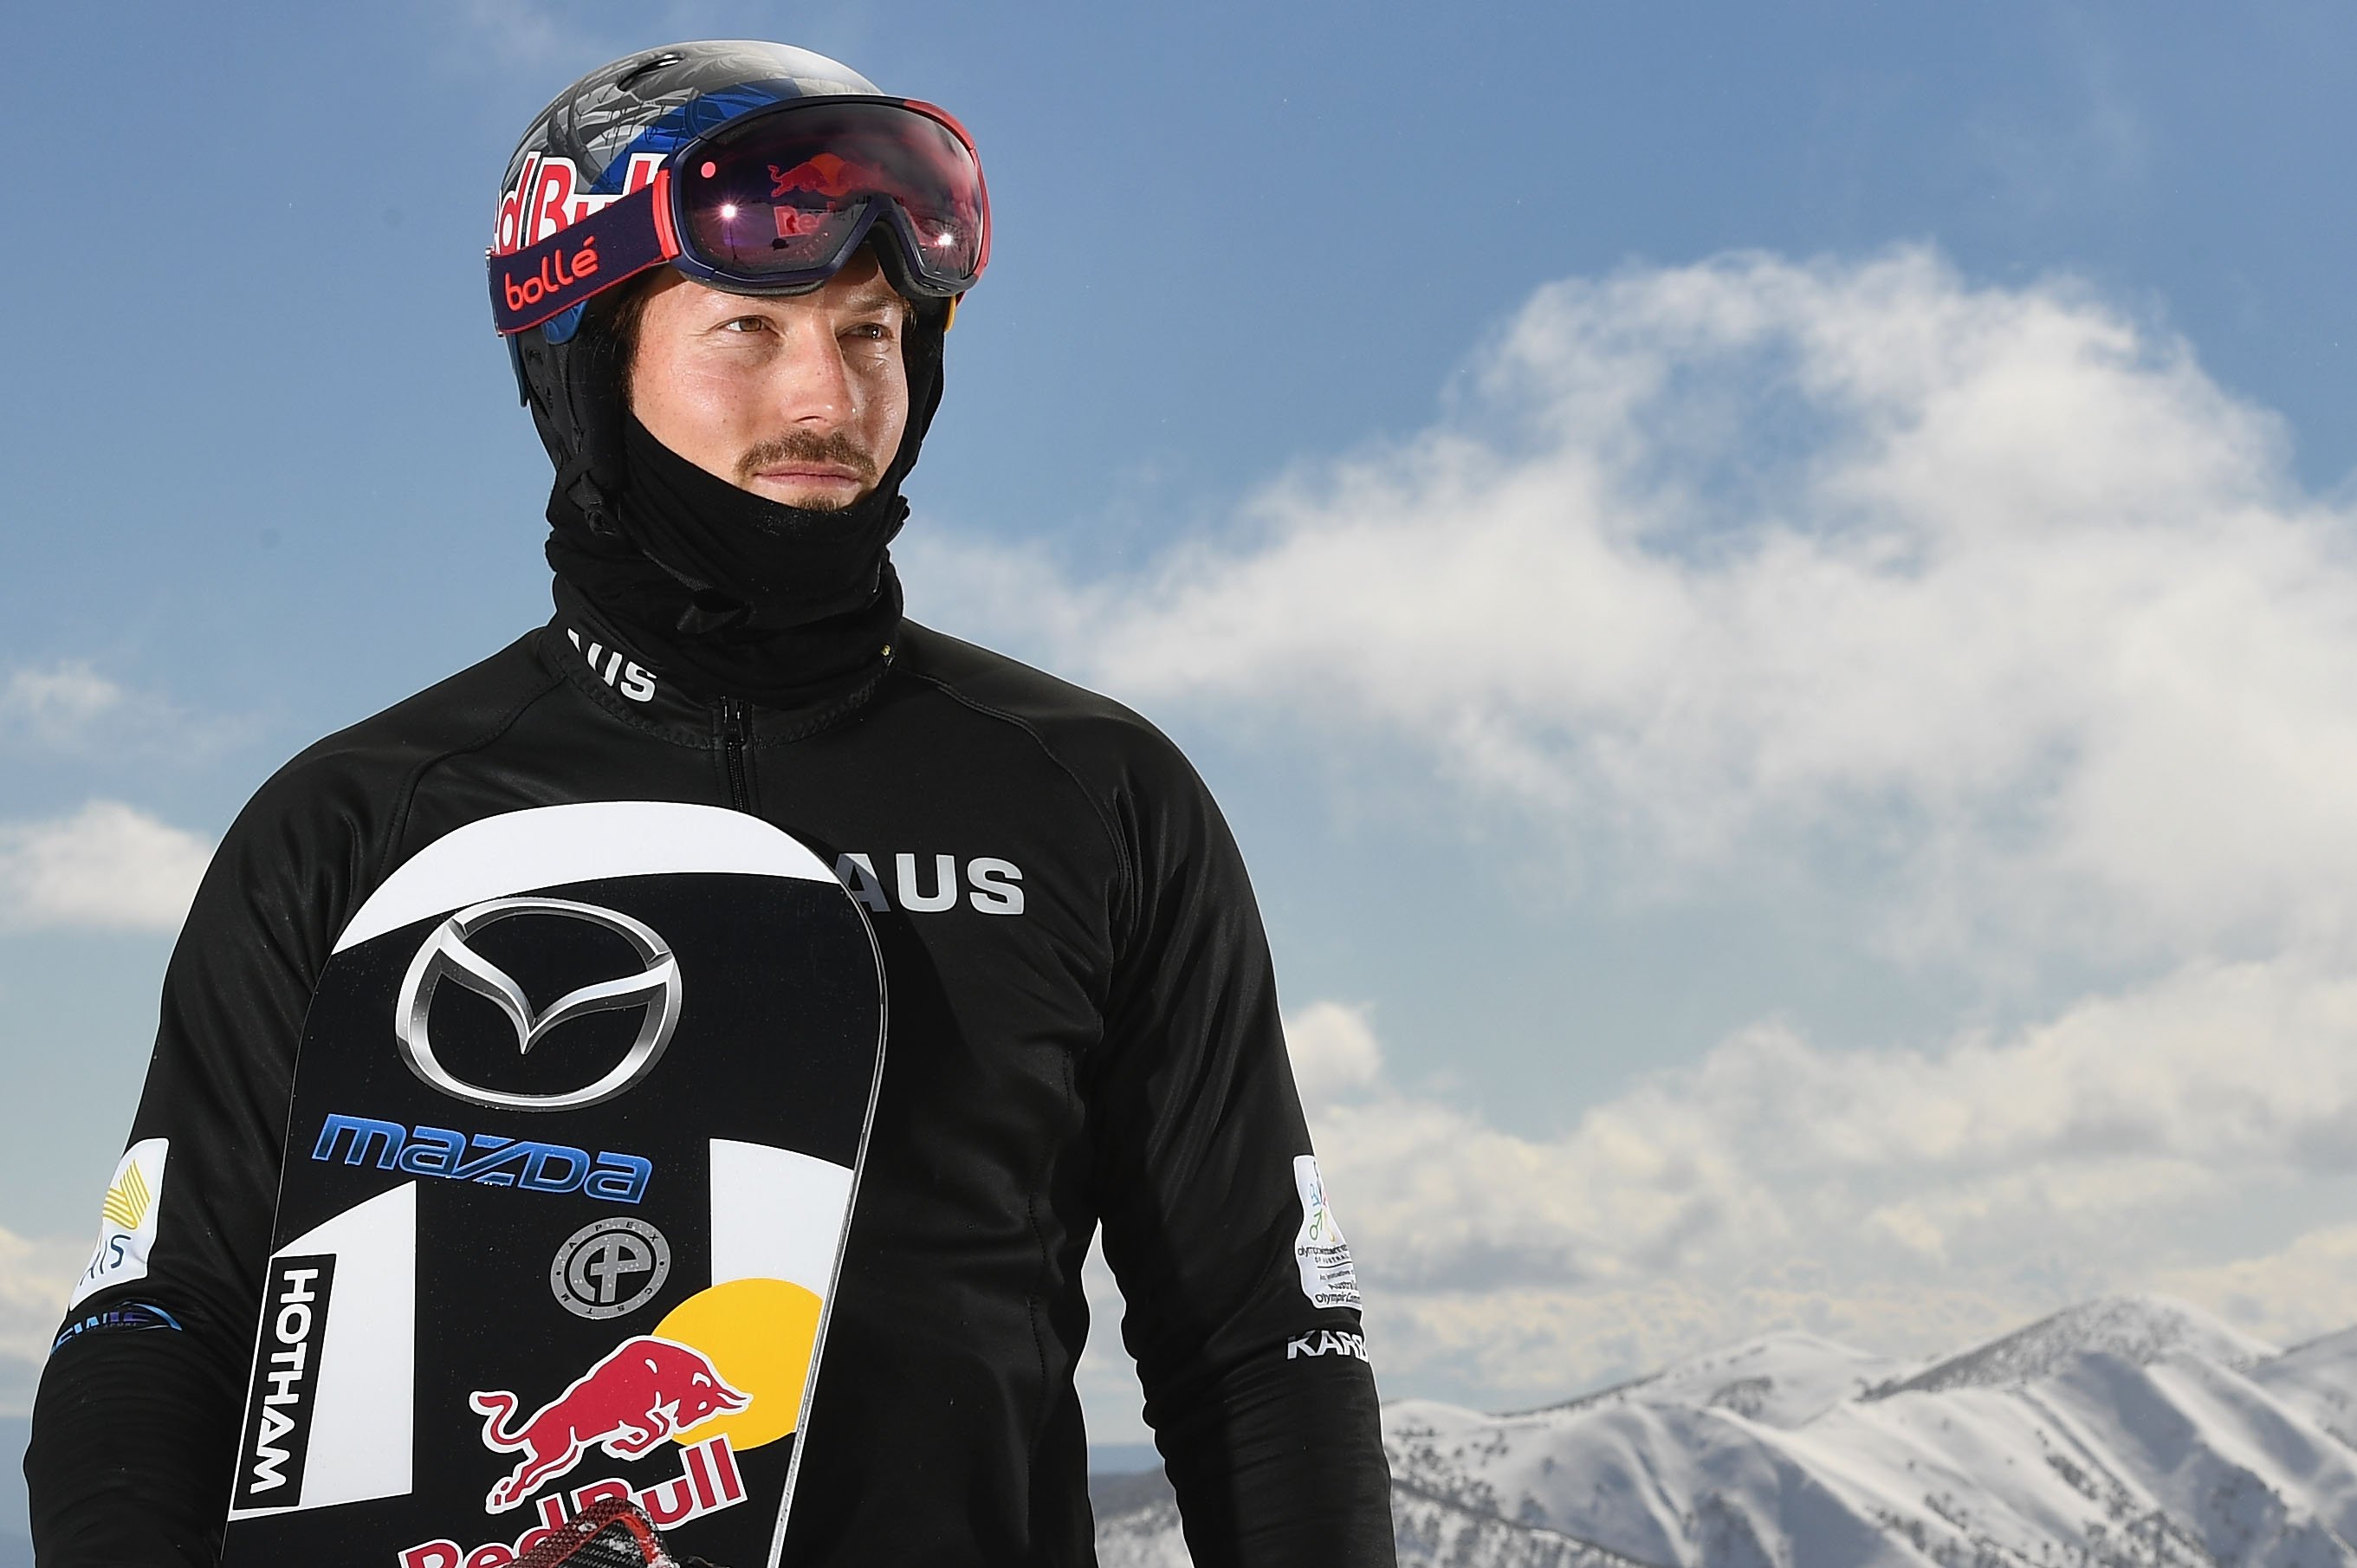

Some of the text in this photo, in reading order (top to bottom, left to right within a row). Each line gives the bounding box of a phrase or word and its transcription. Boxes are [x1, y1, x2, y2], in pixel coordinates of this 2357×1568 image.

[504, 235, 599, 311] bollé
[835, 852, 1026, 915] AUS
[567, 1221, 659, 1249] APEX
[250, 1268, 320, 1493] HOTHAM
